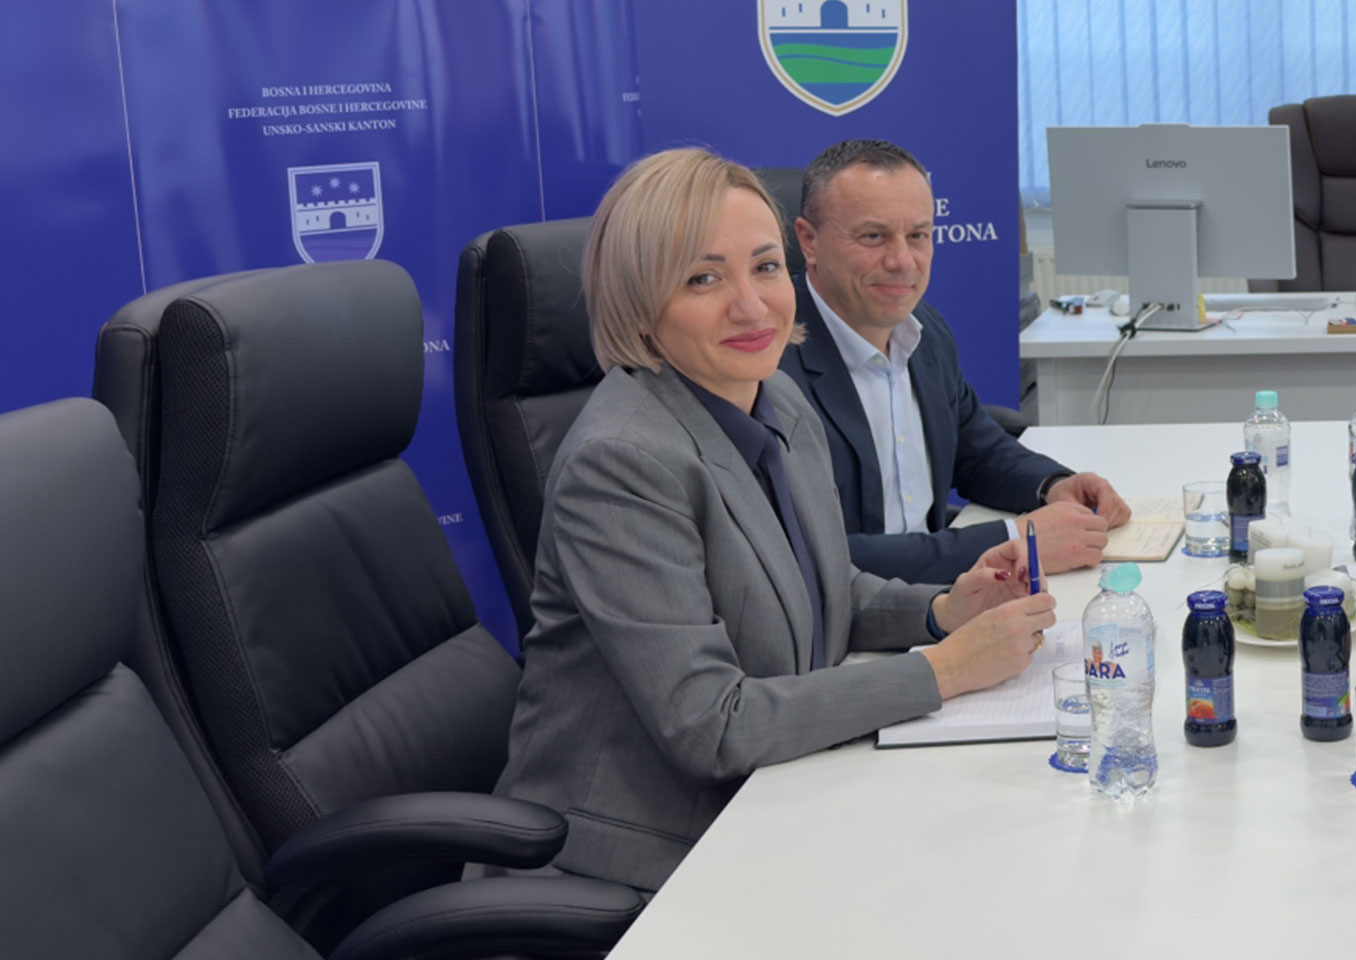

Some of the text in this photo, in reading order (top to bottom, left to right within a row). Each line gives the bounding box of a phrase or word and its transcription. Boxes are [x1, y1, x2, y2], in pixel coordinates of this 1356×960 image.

[262, 83, 392, 98] BOSNA I HERCEGOVINA
[228, 99, 428, 119] FEDERACIJA BOSNE I HERCEGOVINE
[262, 119, 397, 136] UNSKO-SANSKI KANTON
[1146, 158, 1187, 169] Lenovo
